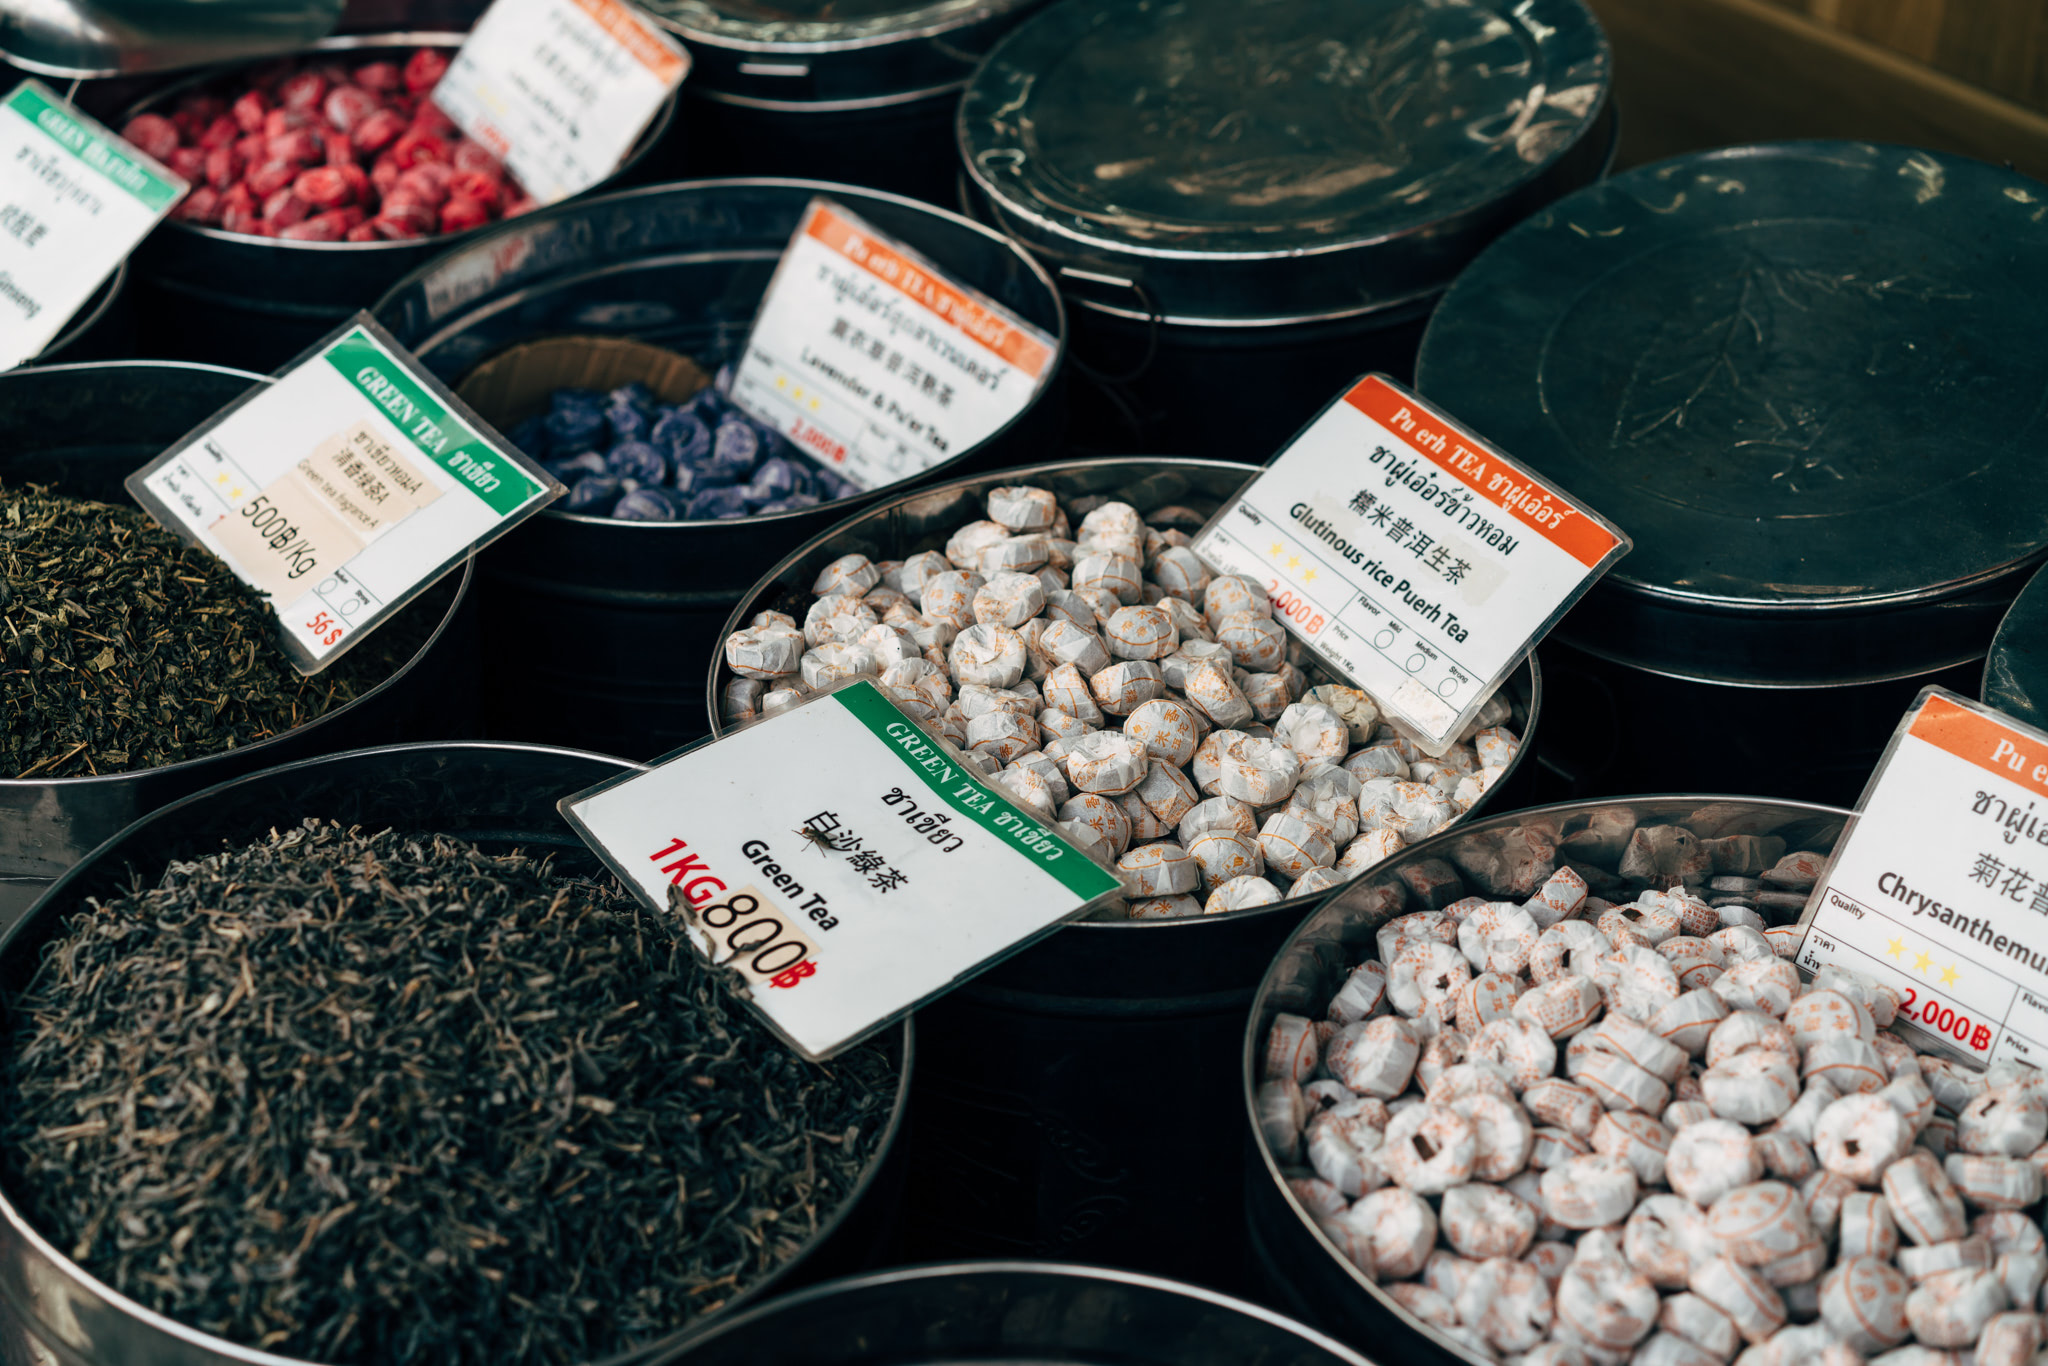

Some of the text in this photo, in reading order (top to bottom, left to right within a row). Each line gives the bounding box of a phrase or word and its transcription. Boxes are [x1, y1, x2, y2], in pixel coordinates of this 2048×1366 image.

[356, 366, 501, 493] GREEN TEA ชาเขียว
[802, 346, 869, 398] Lavender
[873, 393, 885, 410] &
[927, 424, 949, 453] Tea
[298, 459, 324, 483] Green
[322, 483, 337, 497] tea
[1391, 408, 1416, 432] Pu
[1416, 430, 1445, 453] erh
[1449, 445, 1485, 480] TEA
[1239, 506, 1261, 525] Quality
[1349, 490, 1471, 585] 糯米普洱生茶
[1290, 503, 1468, 643] Glutinous rice Puerh Tea
[1318, 642, 1342, 664] Weight
[1334, 625, 1349, 640] Price
[1359, 596, 1468, 683] Flavor Mild Medium Strong
[1989, 737, 2026, 772] Pu
[881, 788, 963, 852] ชาเขียว
[887, 723, 1064, 862] GREEN TEA ชาเขียว
[742, 840, 838, 931] Green Tea
[804, 811, 908, 893] 白沙綠茶
[1831, 895, 1865, 919] Quality
[1878, 872, 2048, 975] Chrysanthemu
[1814, 935, 1835, 952] ราคา
[1900, 988, 1992, 1052] 2,000฿
[2005, 1035, 2030, 1054] Price
